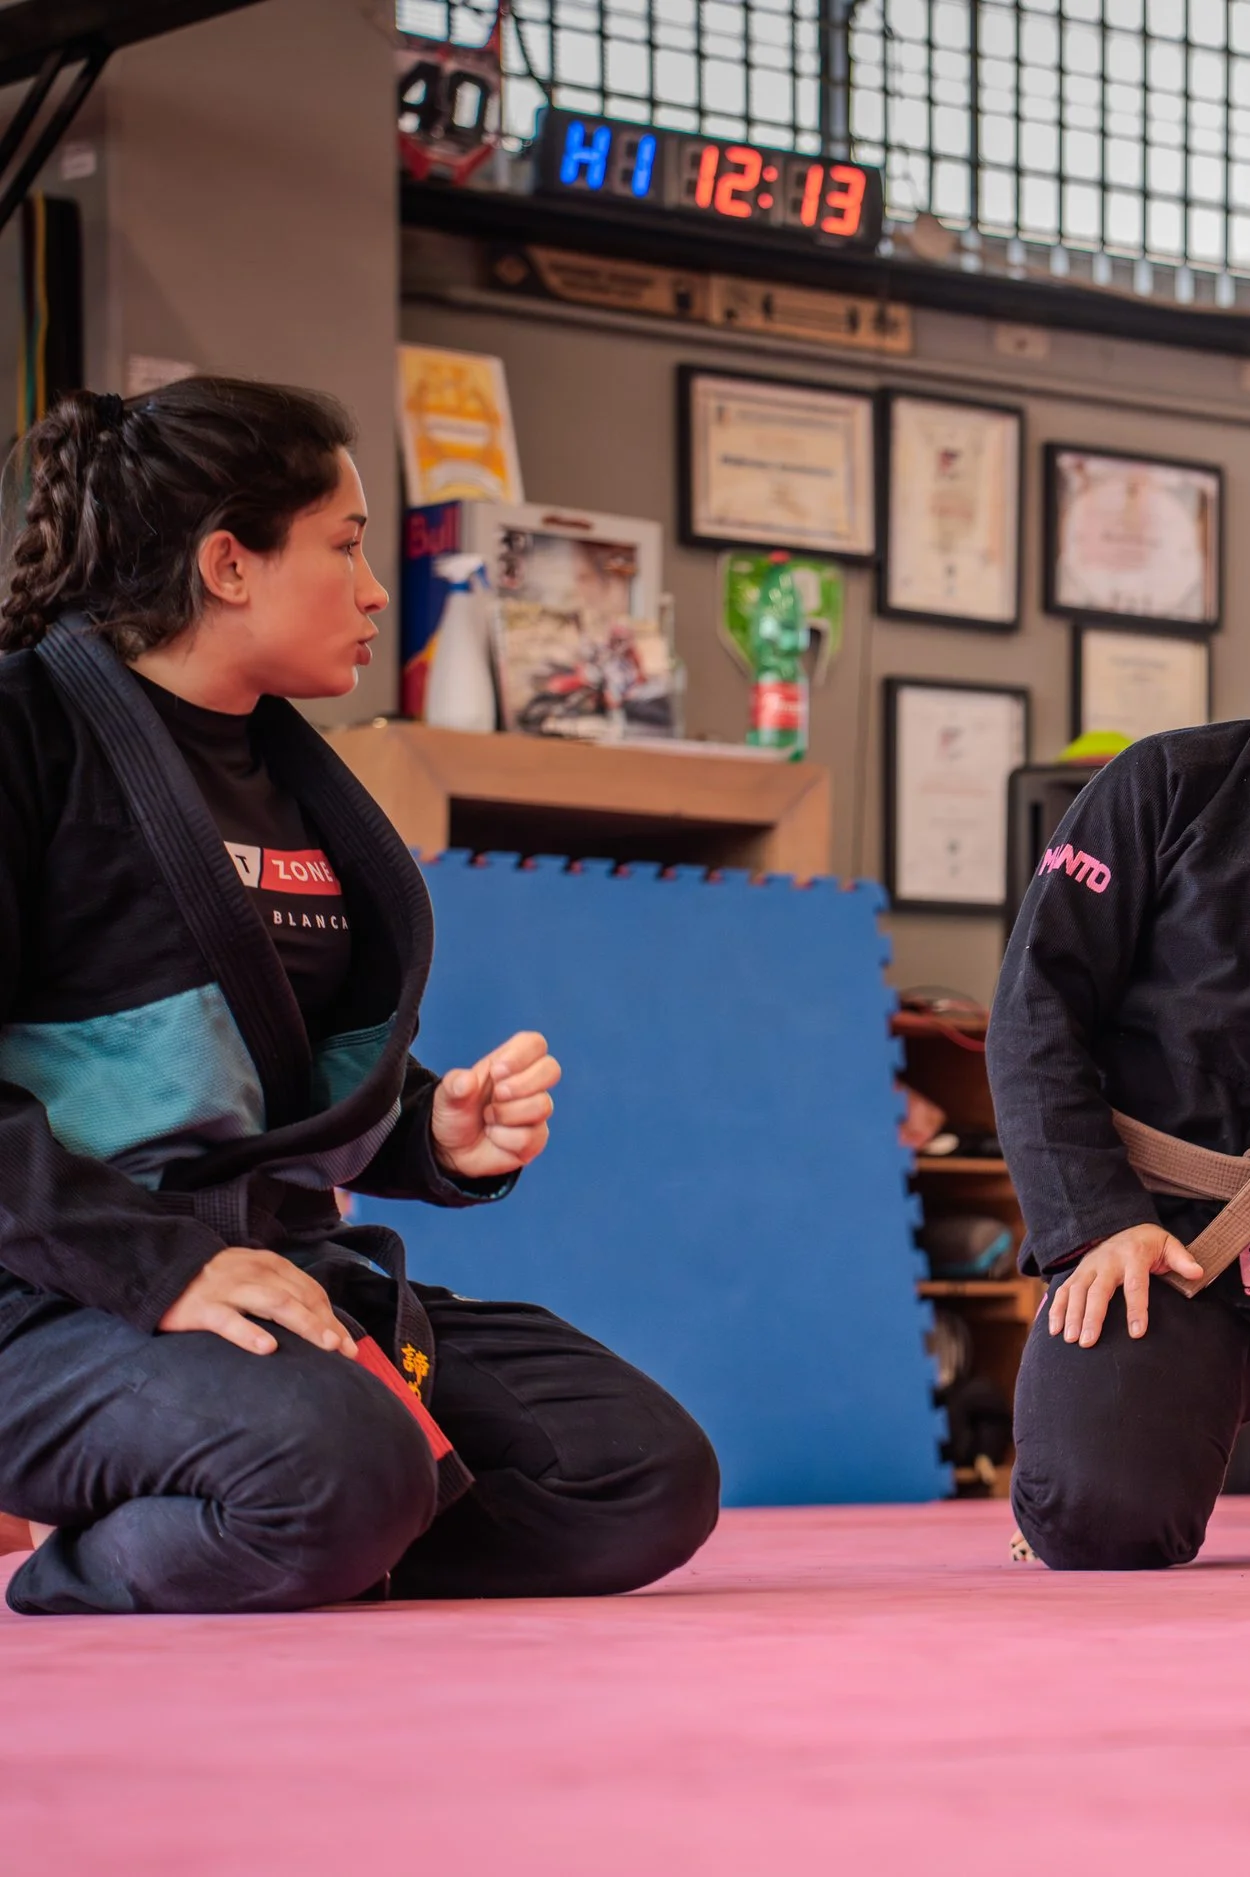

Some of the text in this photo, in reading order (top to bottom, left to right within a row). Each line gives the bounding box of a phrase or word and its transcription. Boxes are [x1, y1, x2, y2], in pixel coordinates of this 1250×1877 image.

[695, 144, 867, 237] 12:13
[271, 859, 334, 882] ZONE
[273, 910, 349, 930] BLANCA
